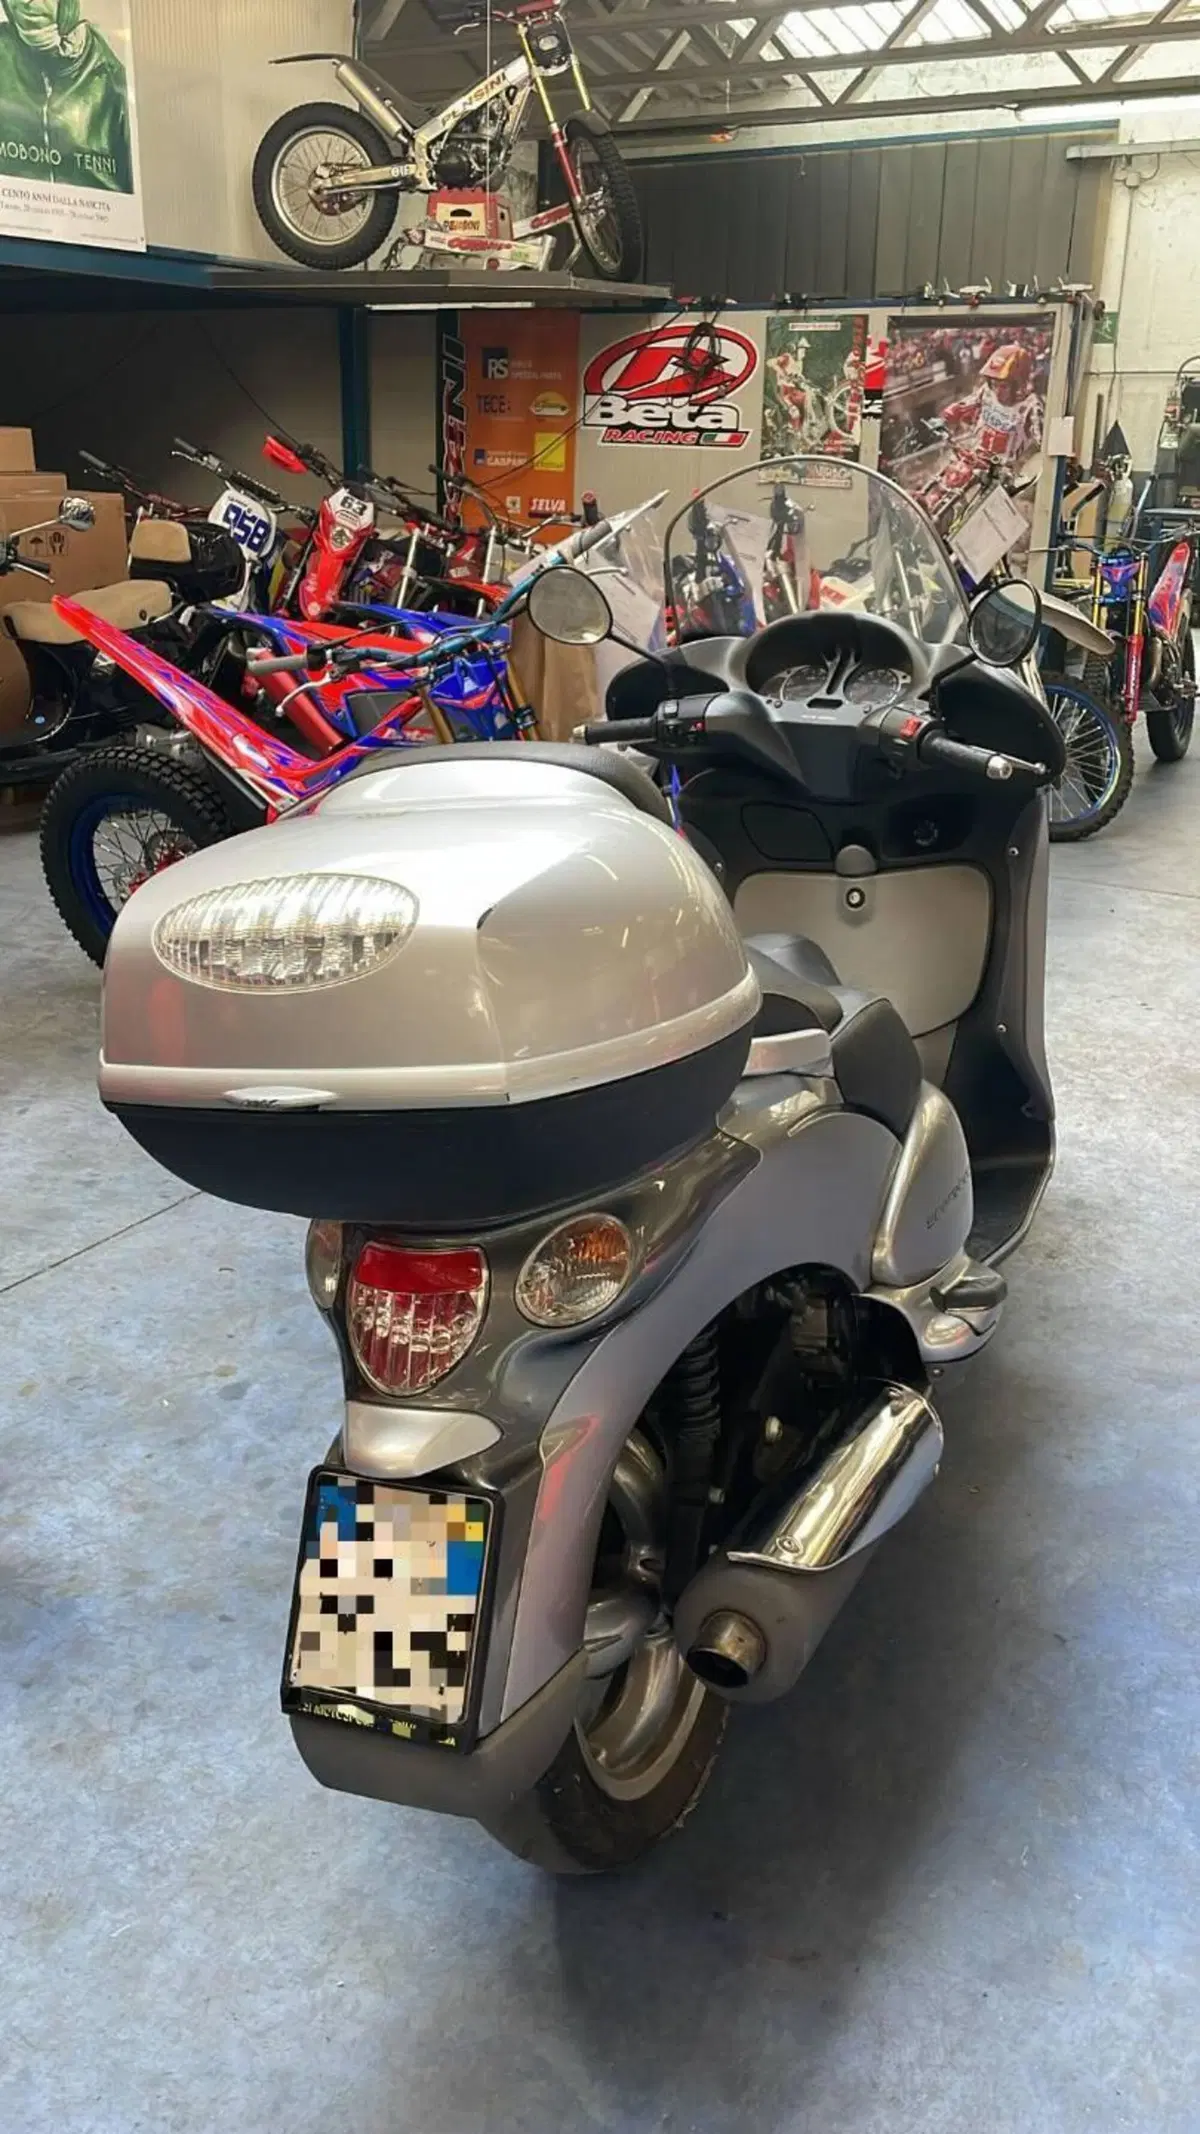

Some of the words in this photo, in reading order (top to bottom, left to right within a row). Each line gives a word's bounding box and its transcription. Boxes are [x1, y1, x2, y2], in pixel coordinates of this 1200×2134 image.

[73, 152, 117, 173] TENNI
[487, 358, 509, 379] RS
[583, 393, 740, 430] Beta
[603, 429, 700, 445] RACING
[340, 496, 367, 515] 63
[530, 498, 566, 511] SELVA
[222, 503, 271, 552] 958
